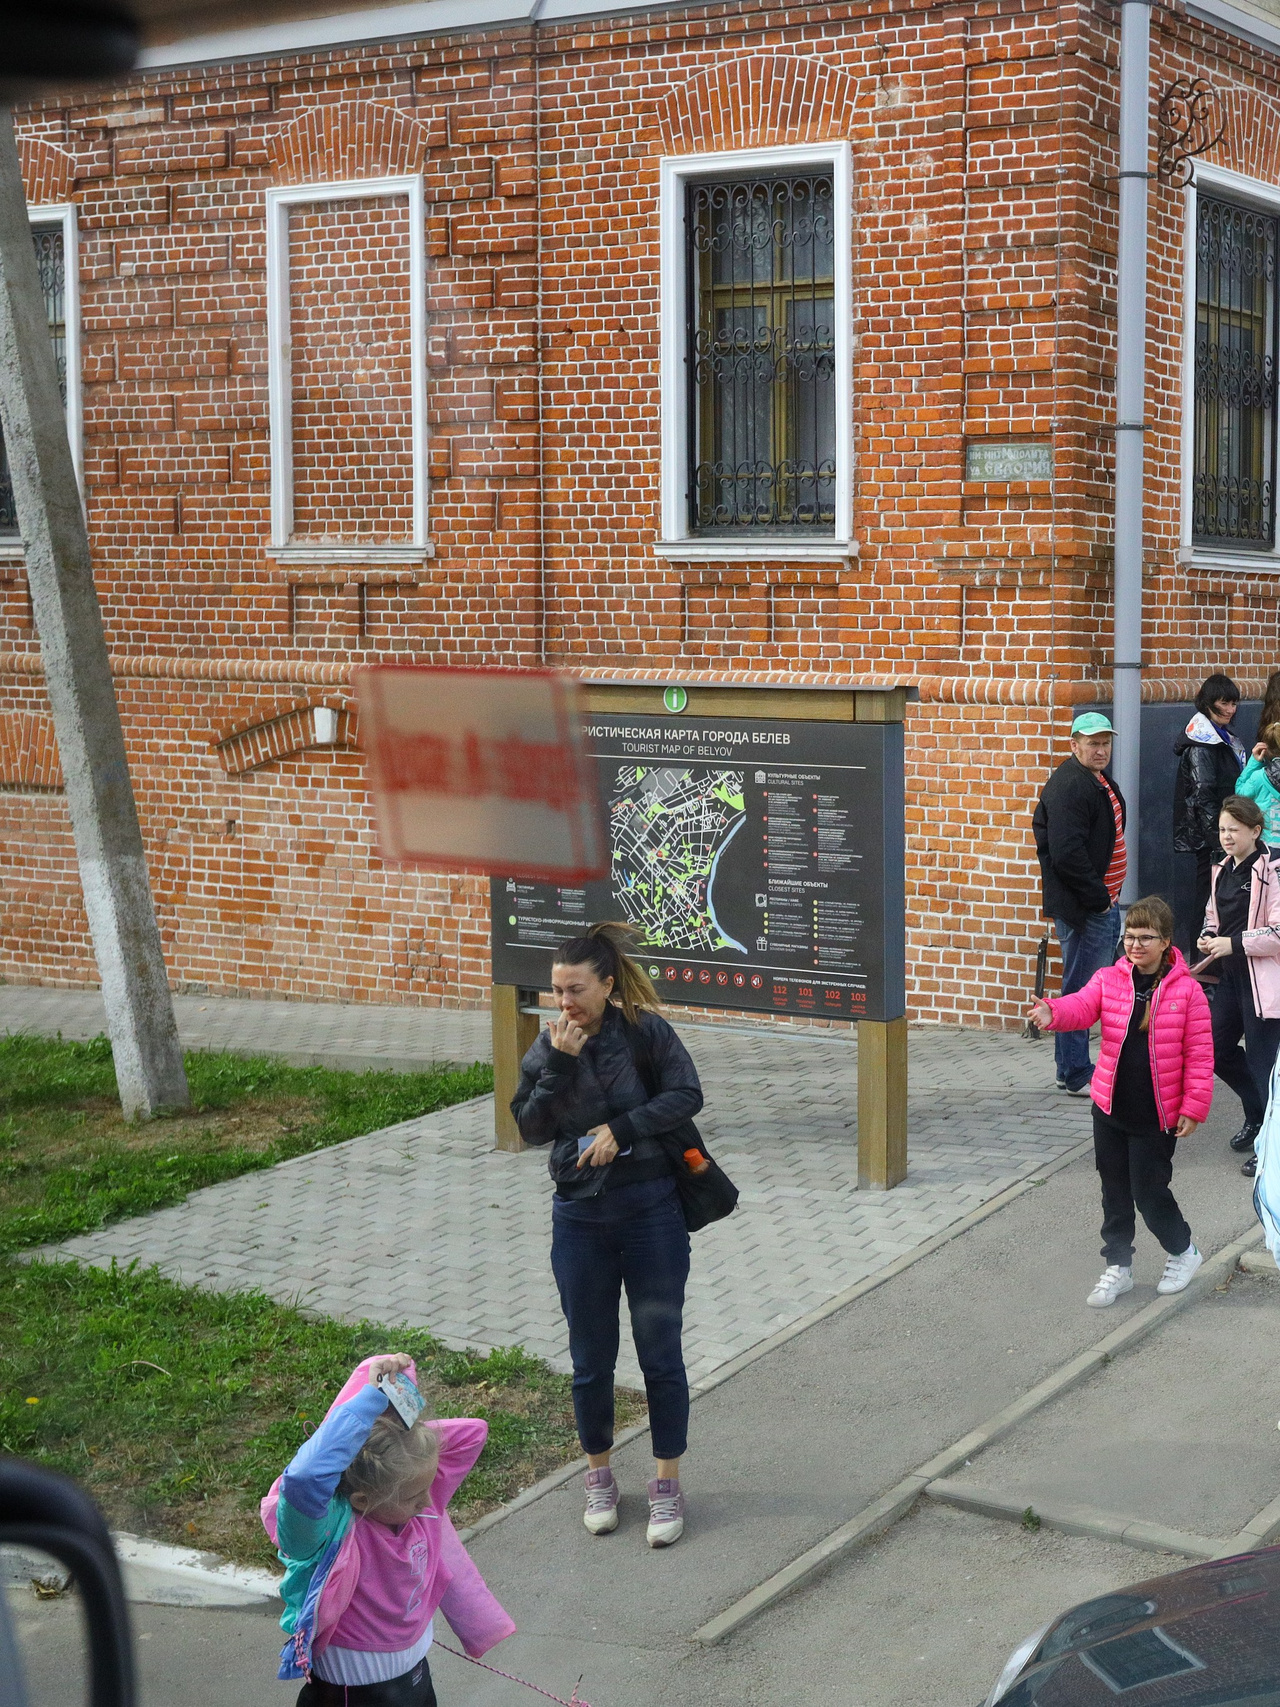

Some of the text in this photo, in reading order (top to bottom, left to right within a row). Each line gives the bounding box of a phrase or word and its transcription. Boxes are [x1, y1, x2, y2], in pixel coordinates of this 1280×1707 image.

[581, 725, 791, 745] РИСТИЧЕСКАЯ КАРТА ГОРОДА БЕЛЕВ
[622, 742, 733, 757] TOURIST MAP OF BELYOV
[773, 985, 788, 995] 112
[798, 987, 813, 997] 101
[824, 990, 841, 1000] 102
[850, 992, 867, 1002] 103
